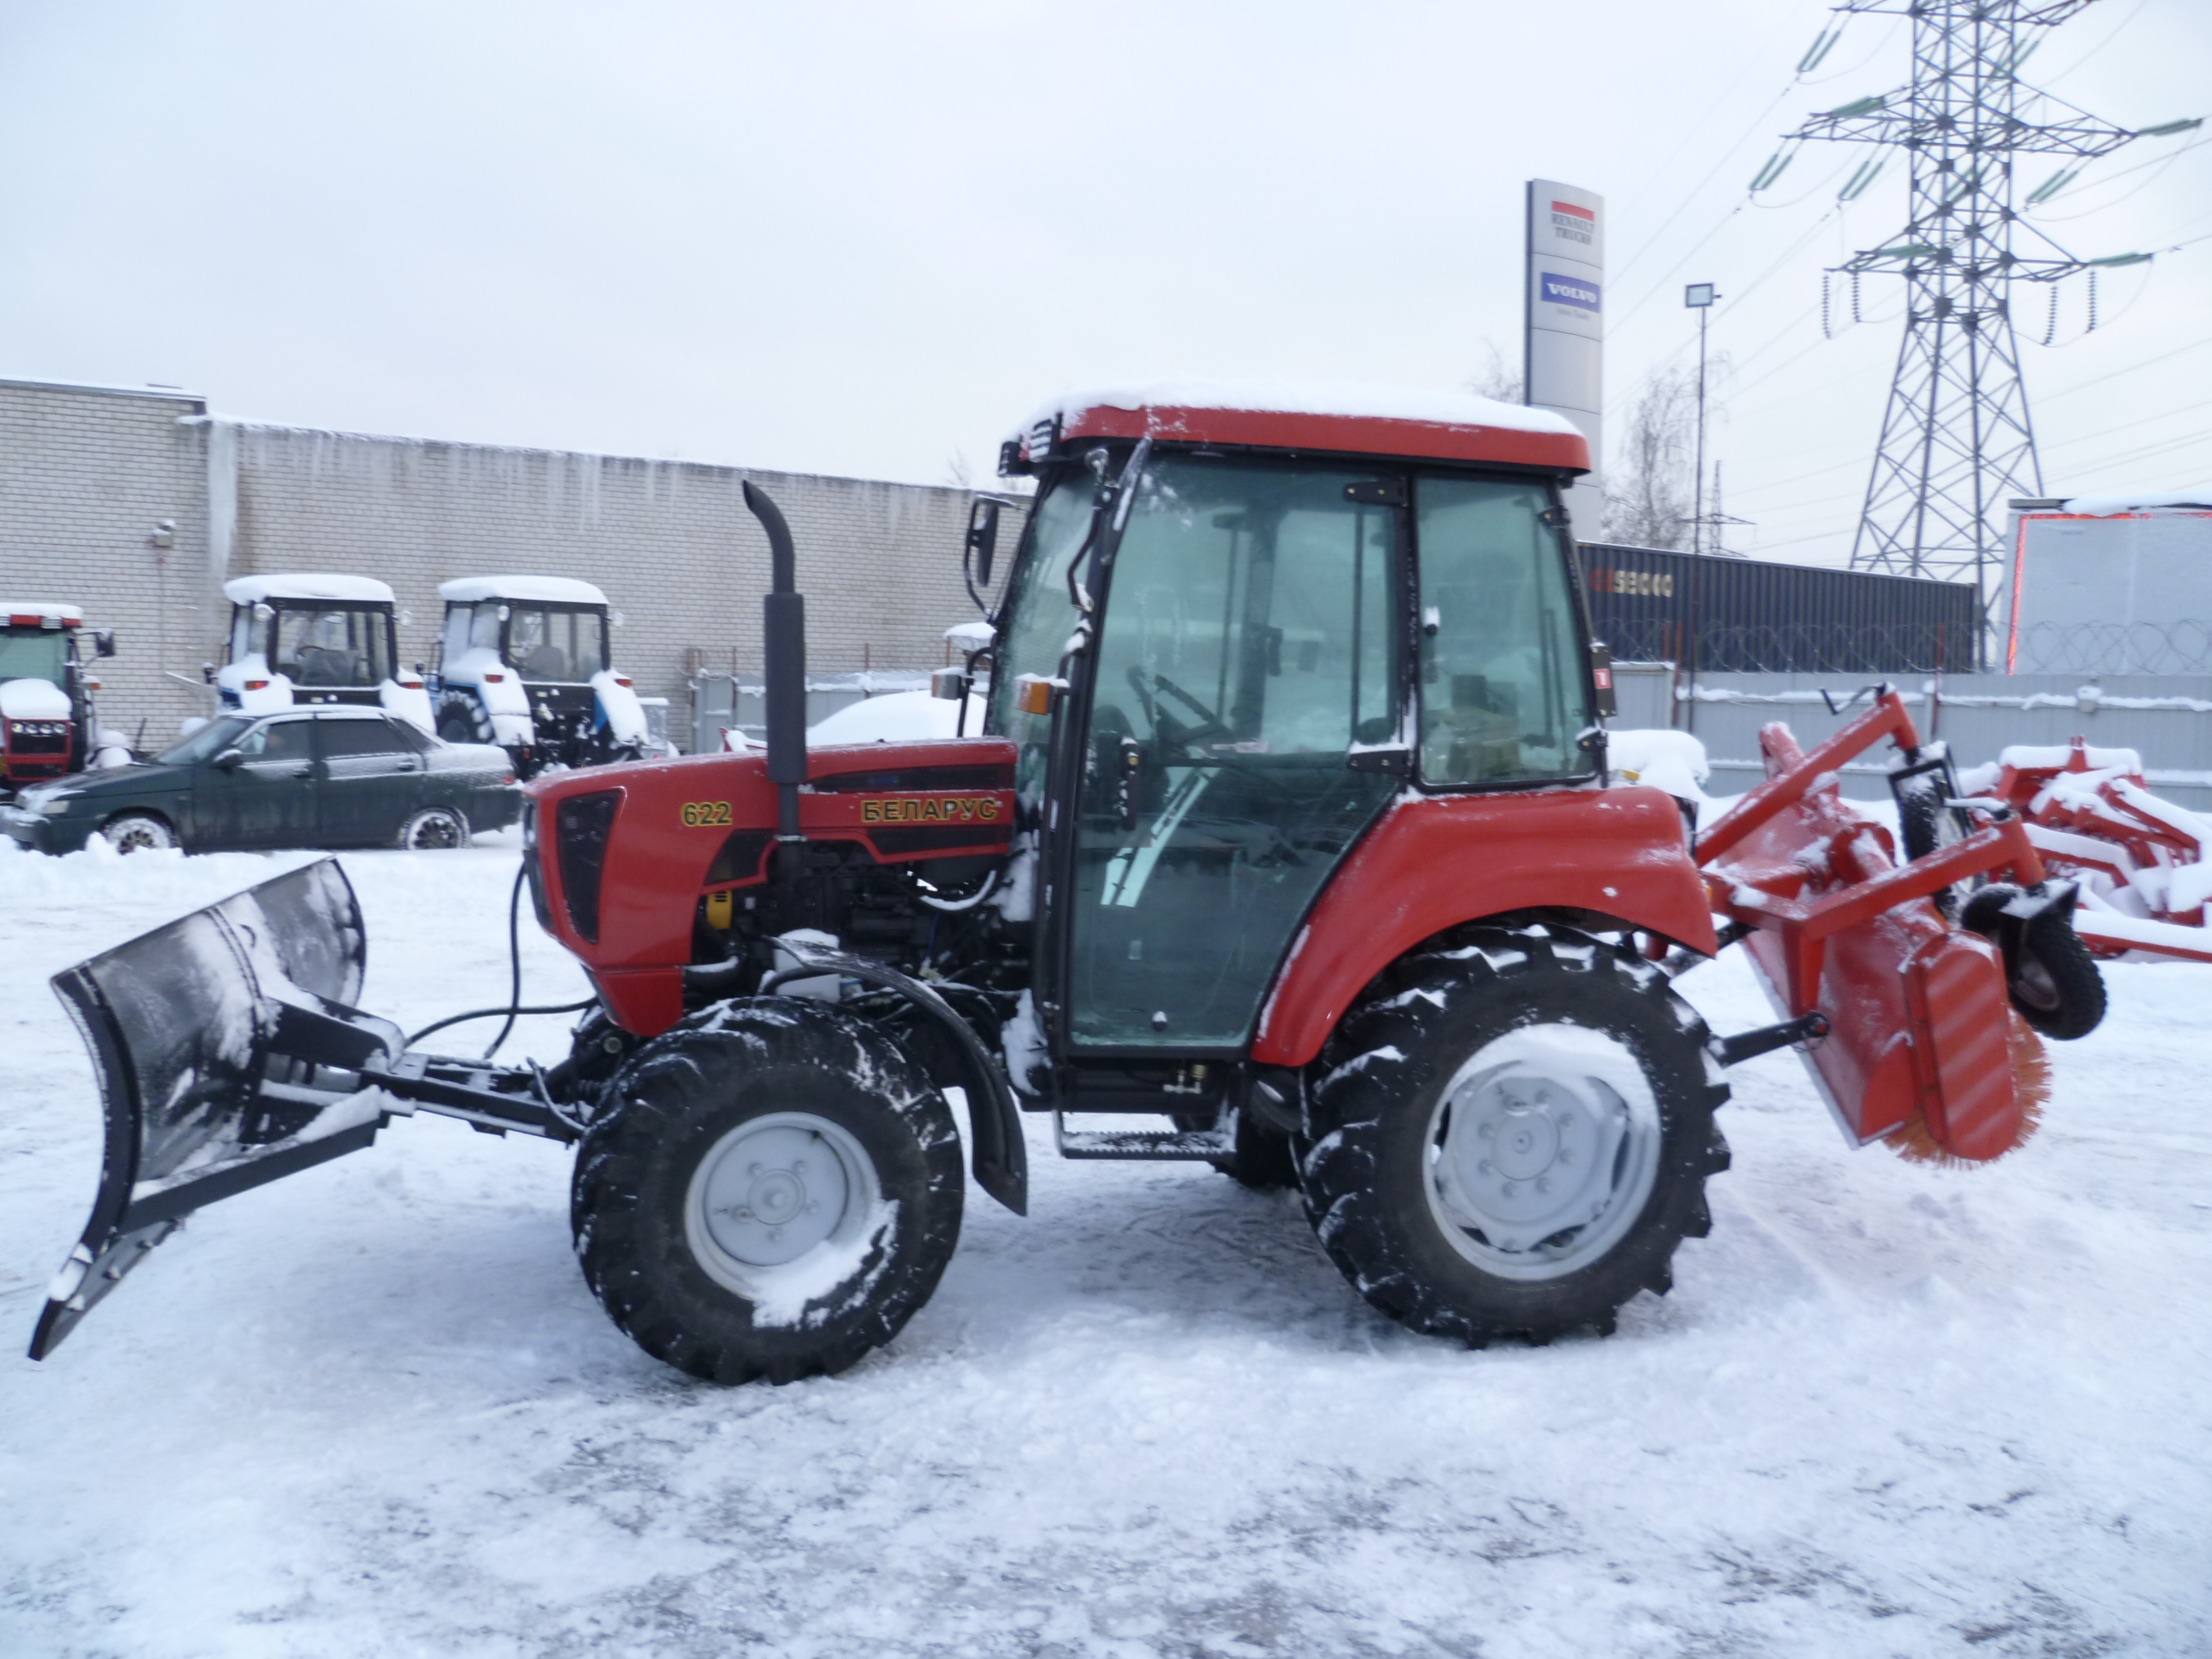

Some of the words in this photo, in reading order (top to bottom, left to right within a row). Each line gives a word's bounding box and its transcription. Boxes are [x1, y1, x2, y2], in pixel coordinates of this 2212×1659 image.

[1546, 283, 1597, 303] VOLVO
[681, 801, 732, 827] 622
[861, 798, 998, 823] БЕЛАРУС
